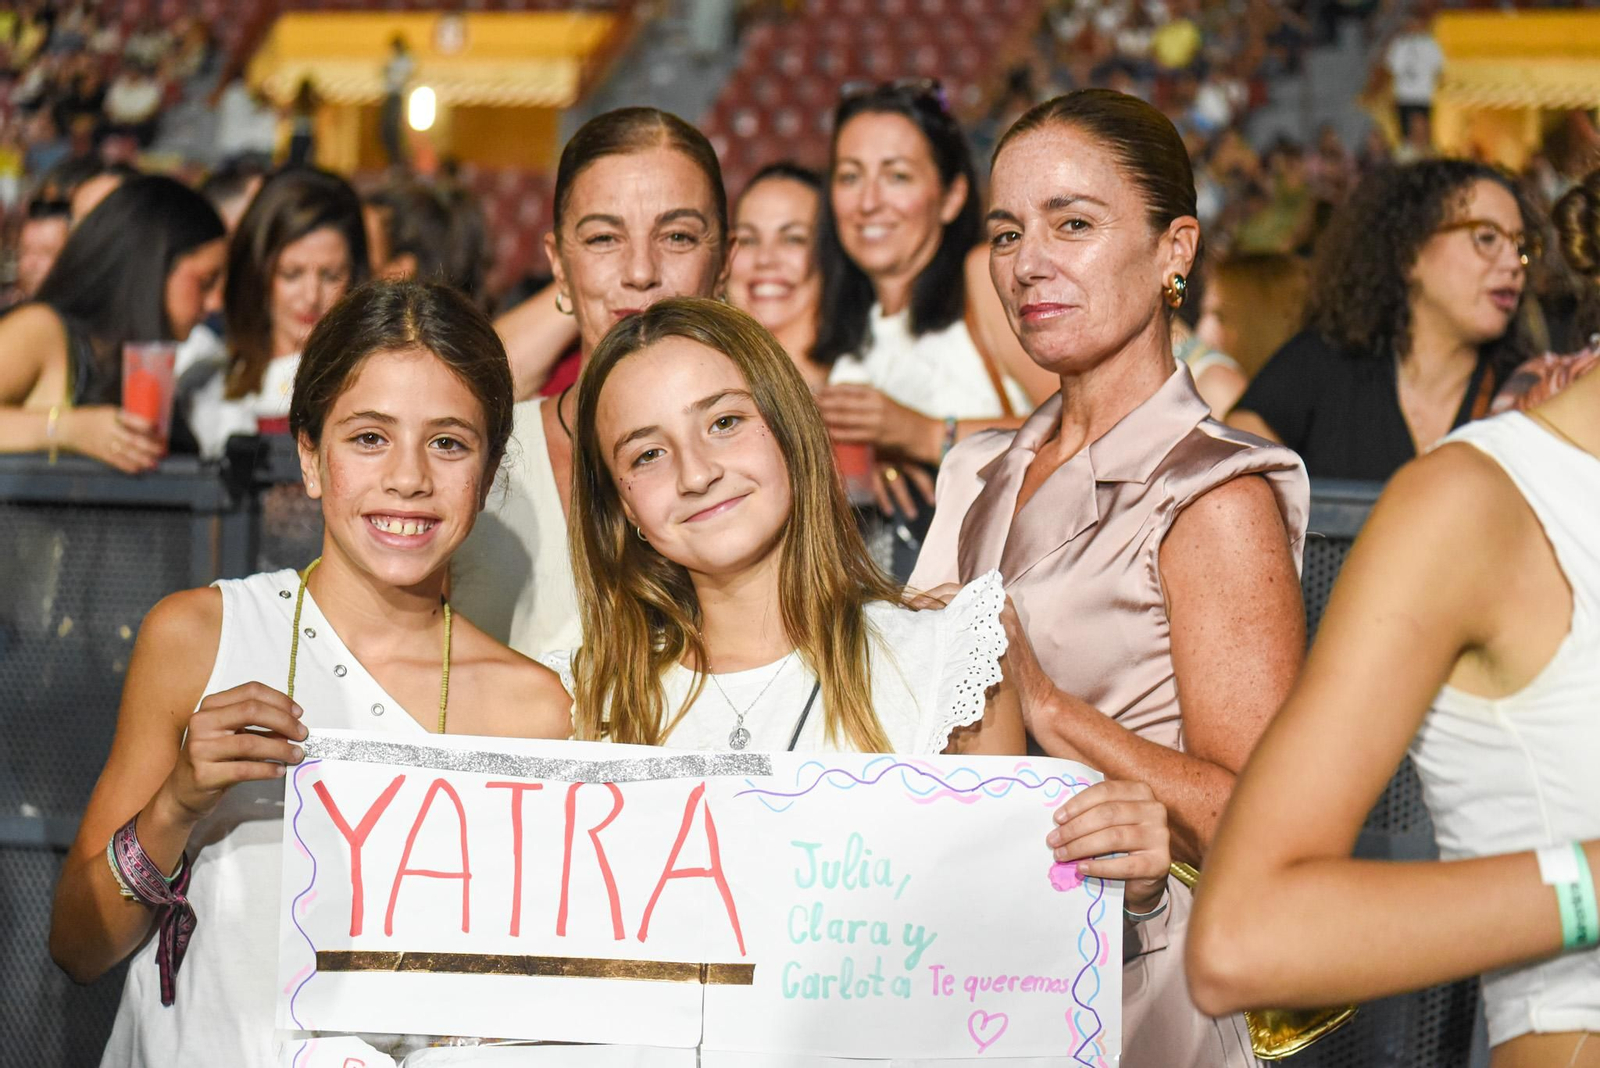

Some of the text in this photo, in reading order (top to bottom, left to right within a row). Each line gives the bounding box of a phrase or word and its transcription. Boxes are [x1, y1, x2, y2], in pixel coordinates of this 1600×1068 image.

[313, 774, 746, 956] YATRA
[791, 832, 912, 900] Julia,
[788, 901, 938, 971] Clara y
[782, 956, 912, 1000] Carlota
[928, 964, 1070, 1002] Te queremos
